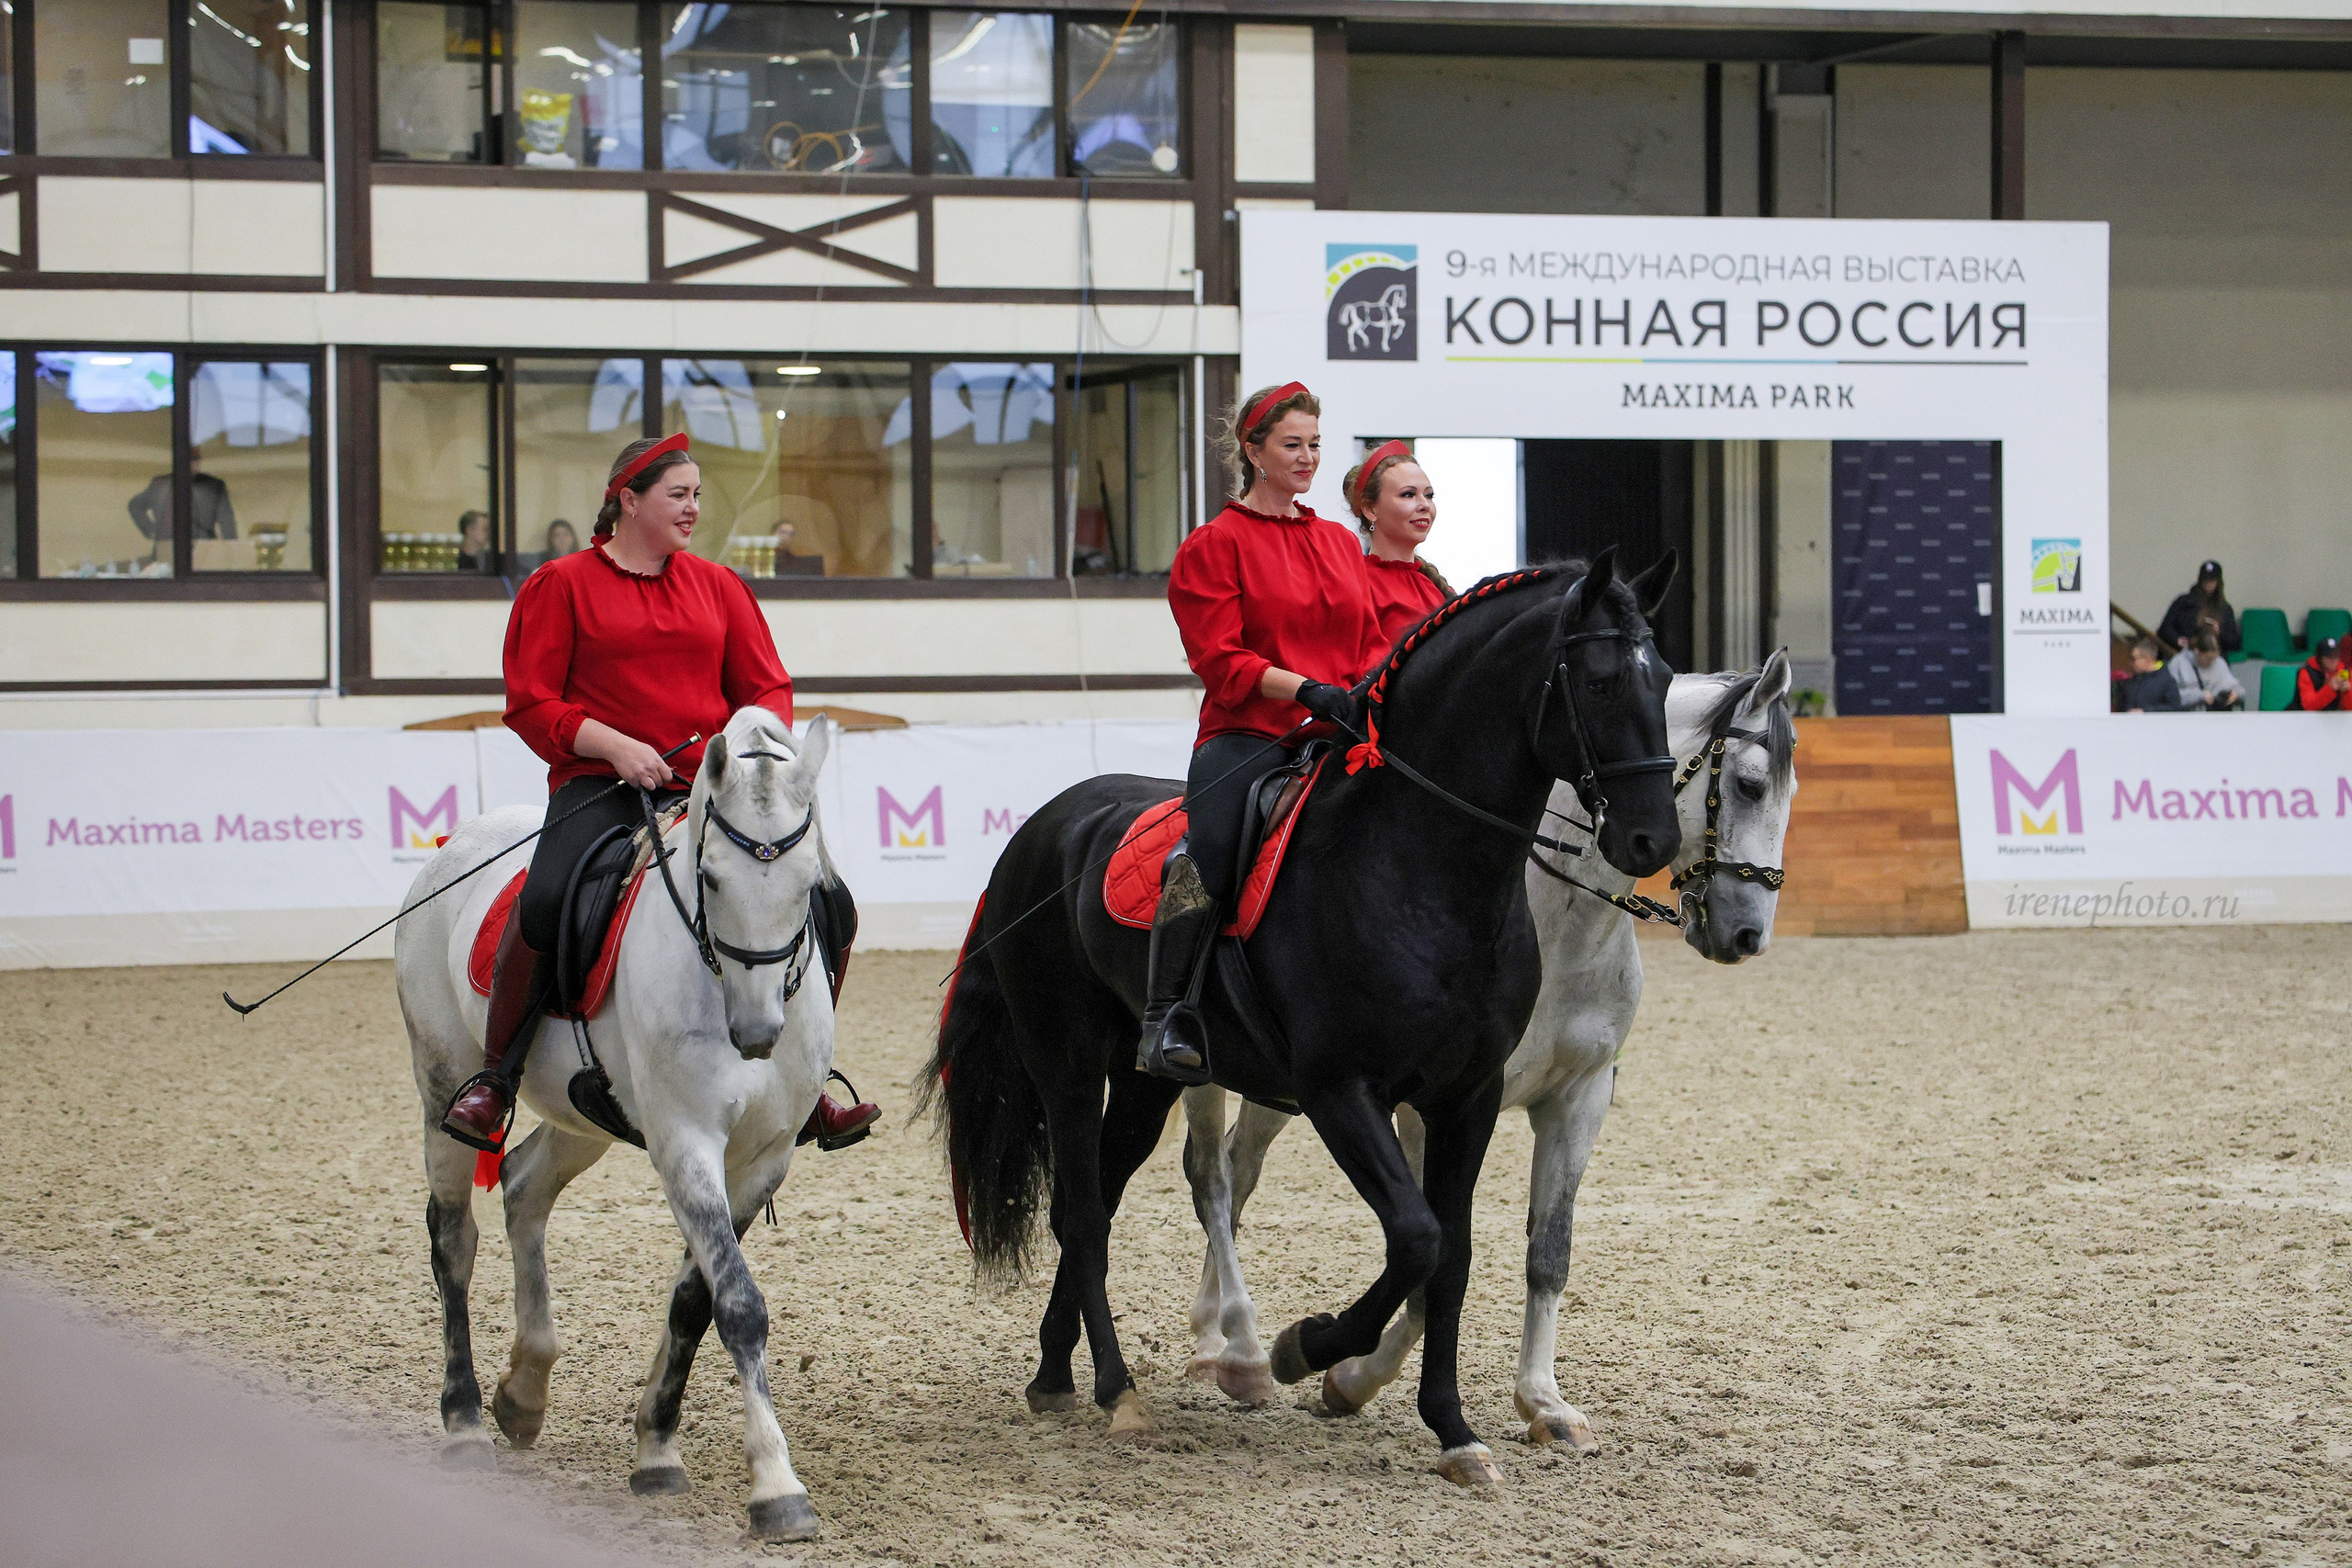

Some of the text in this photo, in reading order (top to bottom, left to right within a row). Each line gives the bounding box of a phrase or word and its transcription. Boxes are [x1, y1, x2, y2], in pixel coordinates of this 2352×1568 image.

[1445, 249, 2026, 284] 9-я МЕЖДУНАРОДНАЯ ВЫСТАВКА
[1444, 296, 2028, 349] КОННАЯ РОССИЯ
[1621, 382, 1855, 410] MAXIMA PARK
[2019, 608, 2094, 624] MAXIMA
[2111, 778, 2320, 821] Maxima
[46, 816, 202, 847] Maxima
[214, 813, 364, 843] Masters
